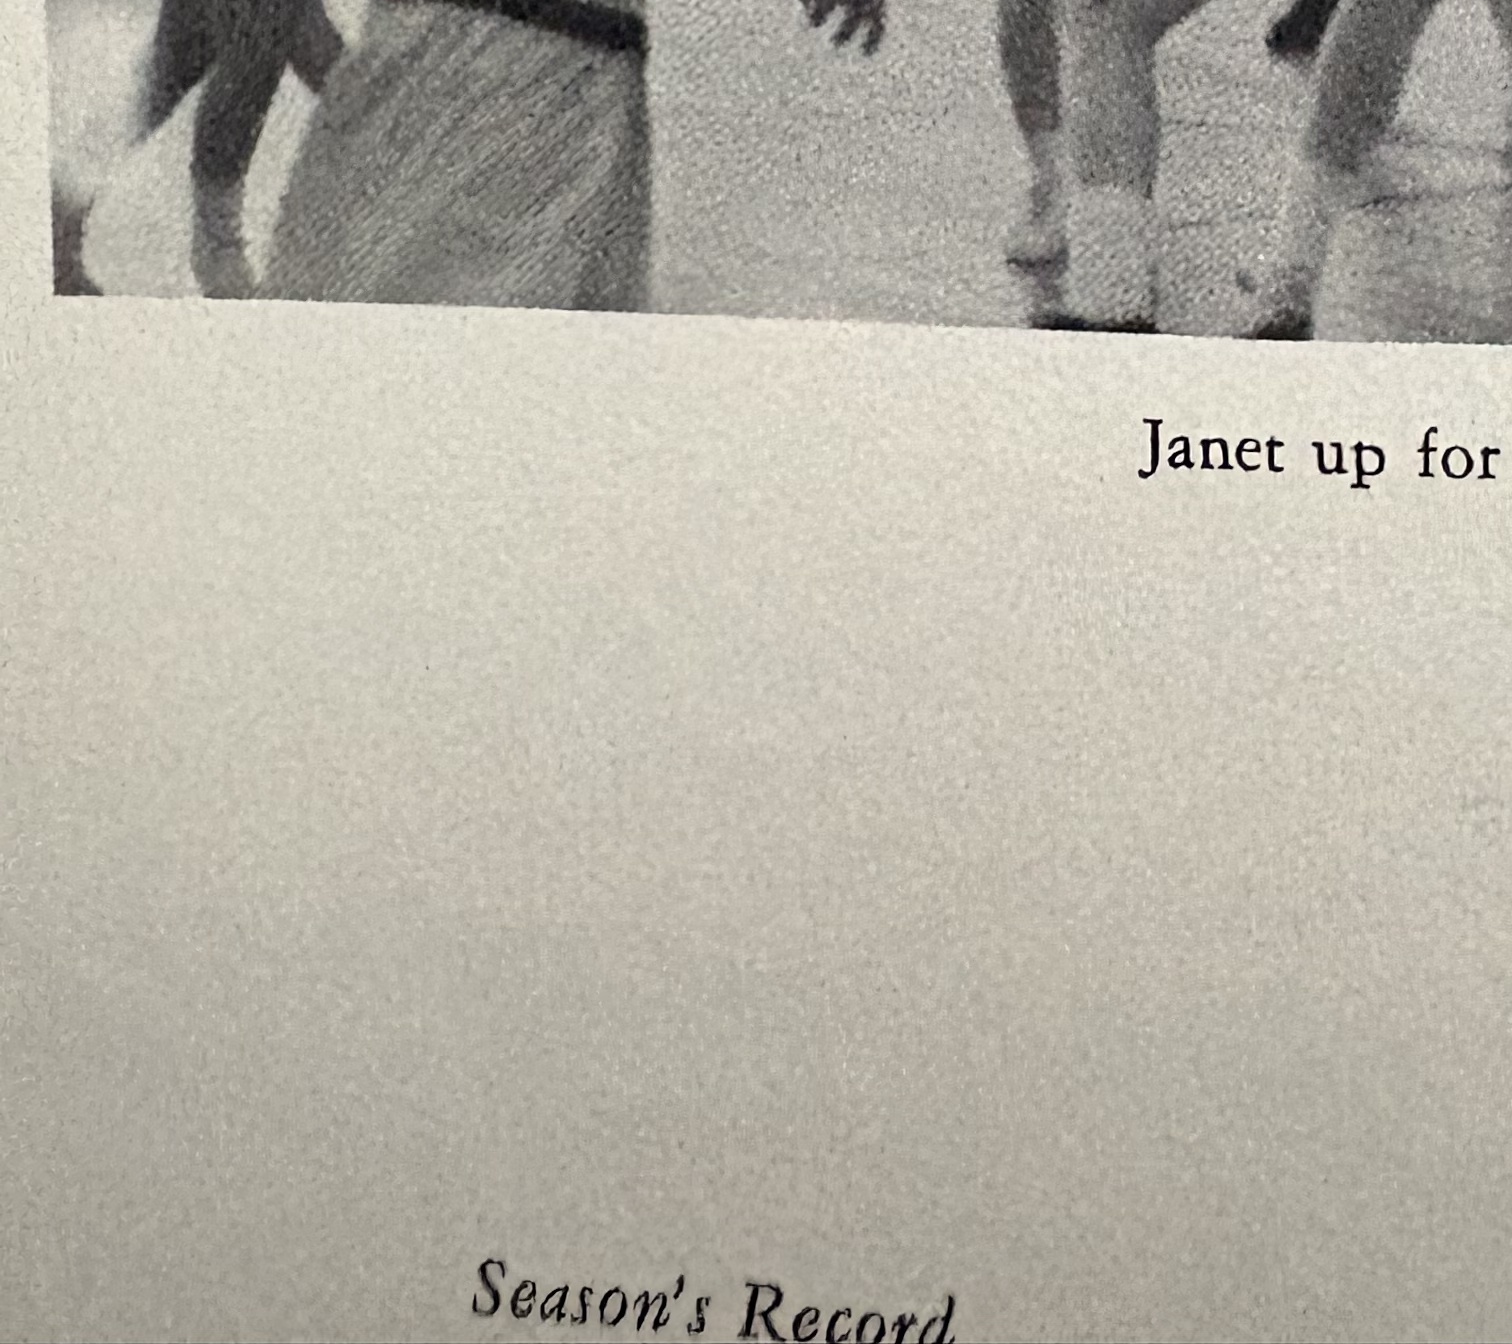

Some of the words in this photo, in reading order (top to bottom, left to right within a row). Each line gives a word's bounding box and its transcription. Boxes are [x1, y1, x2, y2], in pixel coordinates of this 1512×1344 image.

[1137, 418, 1285, 480] Janet
[1311, 440, 1387, 491] up
[1417, 426, 1502, 481] for
[472, 1257, 712, 1337] Season's
[737, 1281, 957, 1344] Record
